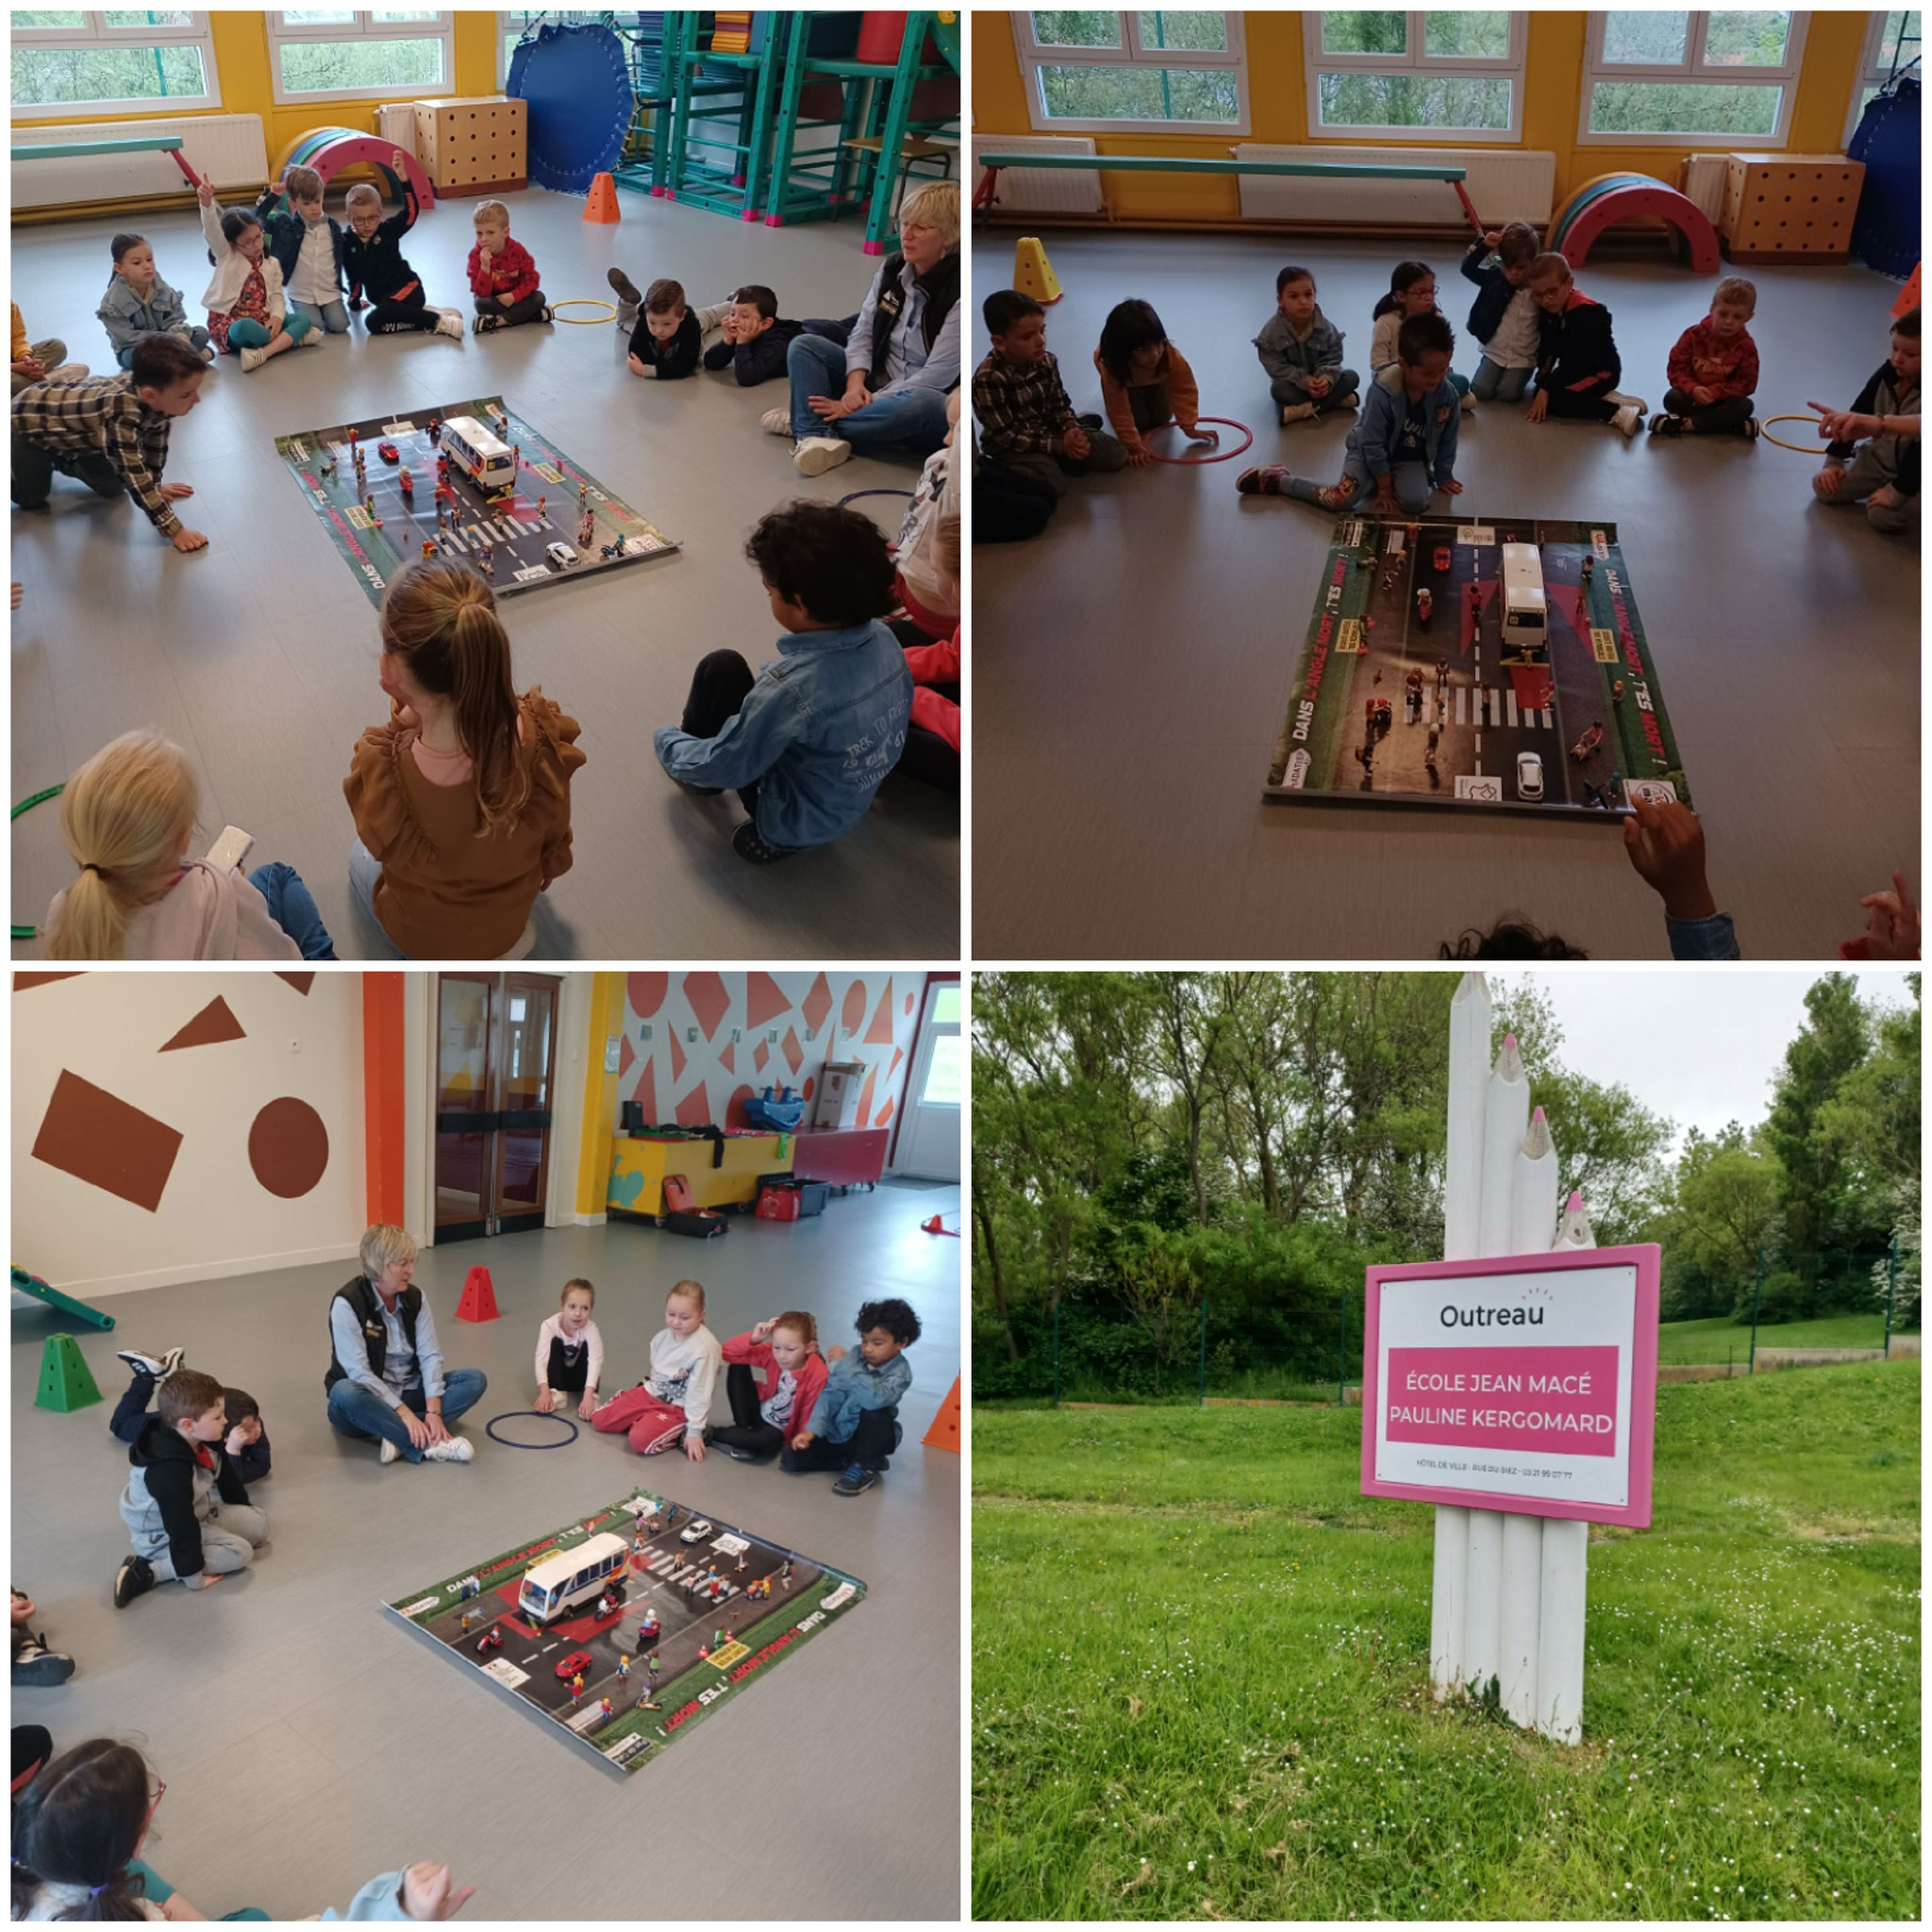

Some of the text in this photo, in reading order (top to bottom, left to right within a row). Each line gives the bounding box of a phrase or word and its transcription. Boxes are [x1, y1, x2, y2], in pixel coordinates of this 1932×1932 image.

[361, 564, 386, 589] DANS
[1605, 568, 1623, 595] DANS
[1291, 700, 1314, 741] DANS
[1303, 645, 1328, 701] L'ANGLE
[1325, 586, 1341, 607] T'ES
[1632, 681, 1654, 711] T'ES
[1640, 710, 1665, 758] MORT
[1440, 1305, 1544, 1327] Outreau
[1407, 1370, 1592, 1395] ÉCOLE JEAN MACÉ
[1390, 1406, 1613, 1434] PAULINE KERGOMARD
[1438, 1461, 1448, 1470] DE
[1449, 1462, 1468, 1472] VILLE
[1472, 1464, 1488, 1473] RUE
[1488, 1465, 1499, 1474] DU
[1541, 1470, 1551, 1478] 99
[446, 1575, 475, 1593] DAN
[796, 1610, 826, 1633] DANS
[758, 1627, 802, 1662] L'ANGLE
[698, 1682, 728, 1706] T'ES
[664, 1700, 702, 1732] MORT
